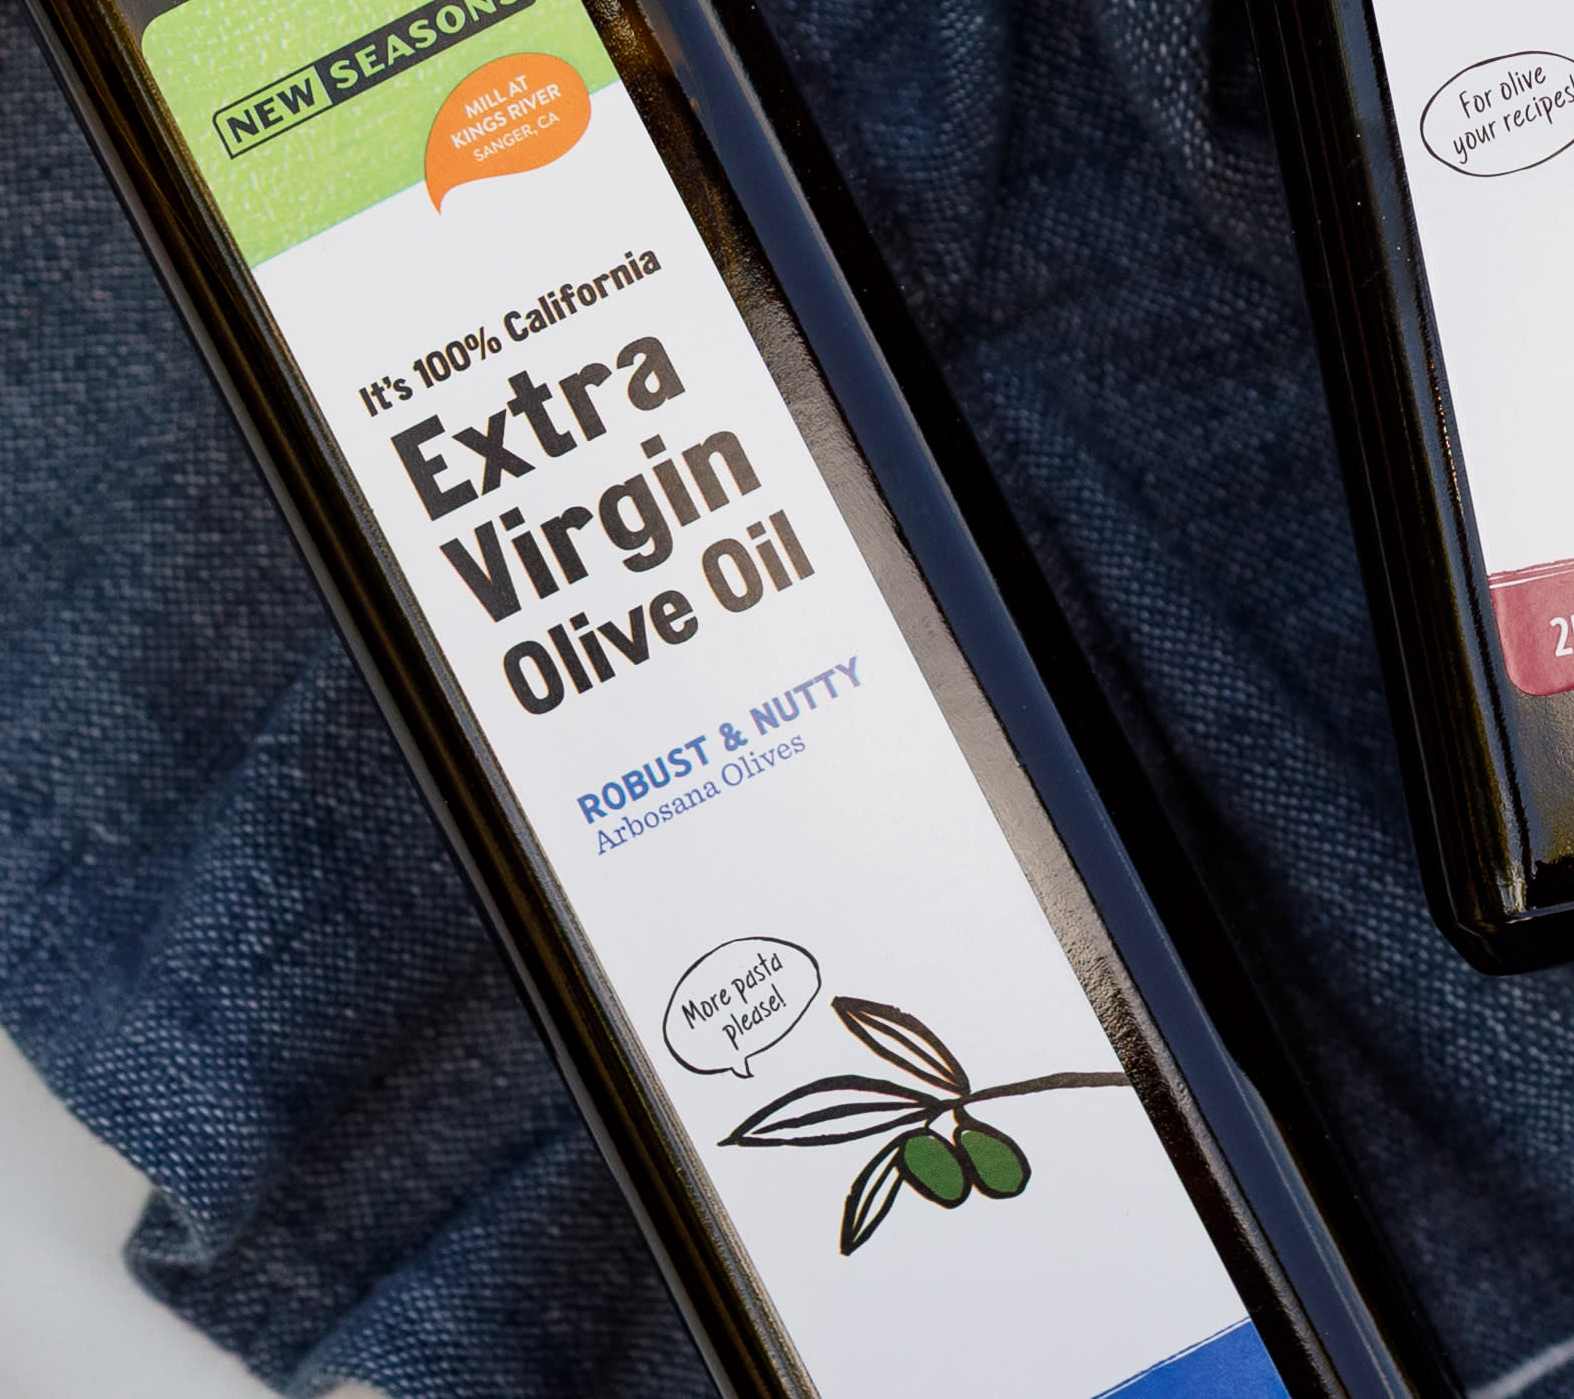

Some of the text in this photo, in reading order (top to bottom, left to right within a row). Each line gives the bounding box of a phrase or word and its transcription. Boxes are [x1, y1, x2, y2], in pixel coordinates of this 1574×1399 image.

[225, 79, 316, 144] NEW
[450, 83, 561, 149] KINGS RIVER
[464, 75, 528, 118] MILL AT
[1459, 67, 1546, 119] For olive
[473, 112, 560, 162] SANGER, CA
[1453, 120, 1496, 164] your
[359, 250, 662, 418] It's 100% California
[391, 336, 686, 522] Extra
[439, 431, 762, 623] Virgin
[502, 509, 815, 715] Olive Oil
[576, 655, 862, 824] ROBUST & NUTTY
[597, 733, 806, 855] Arbosana Olives
[682, 953, 783, 1029] More pasta
[722, 983, 786, 1051] please!
